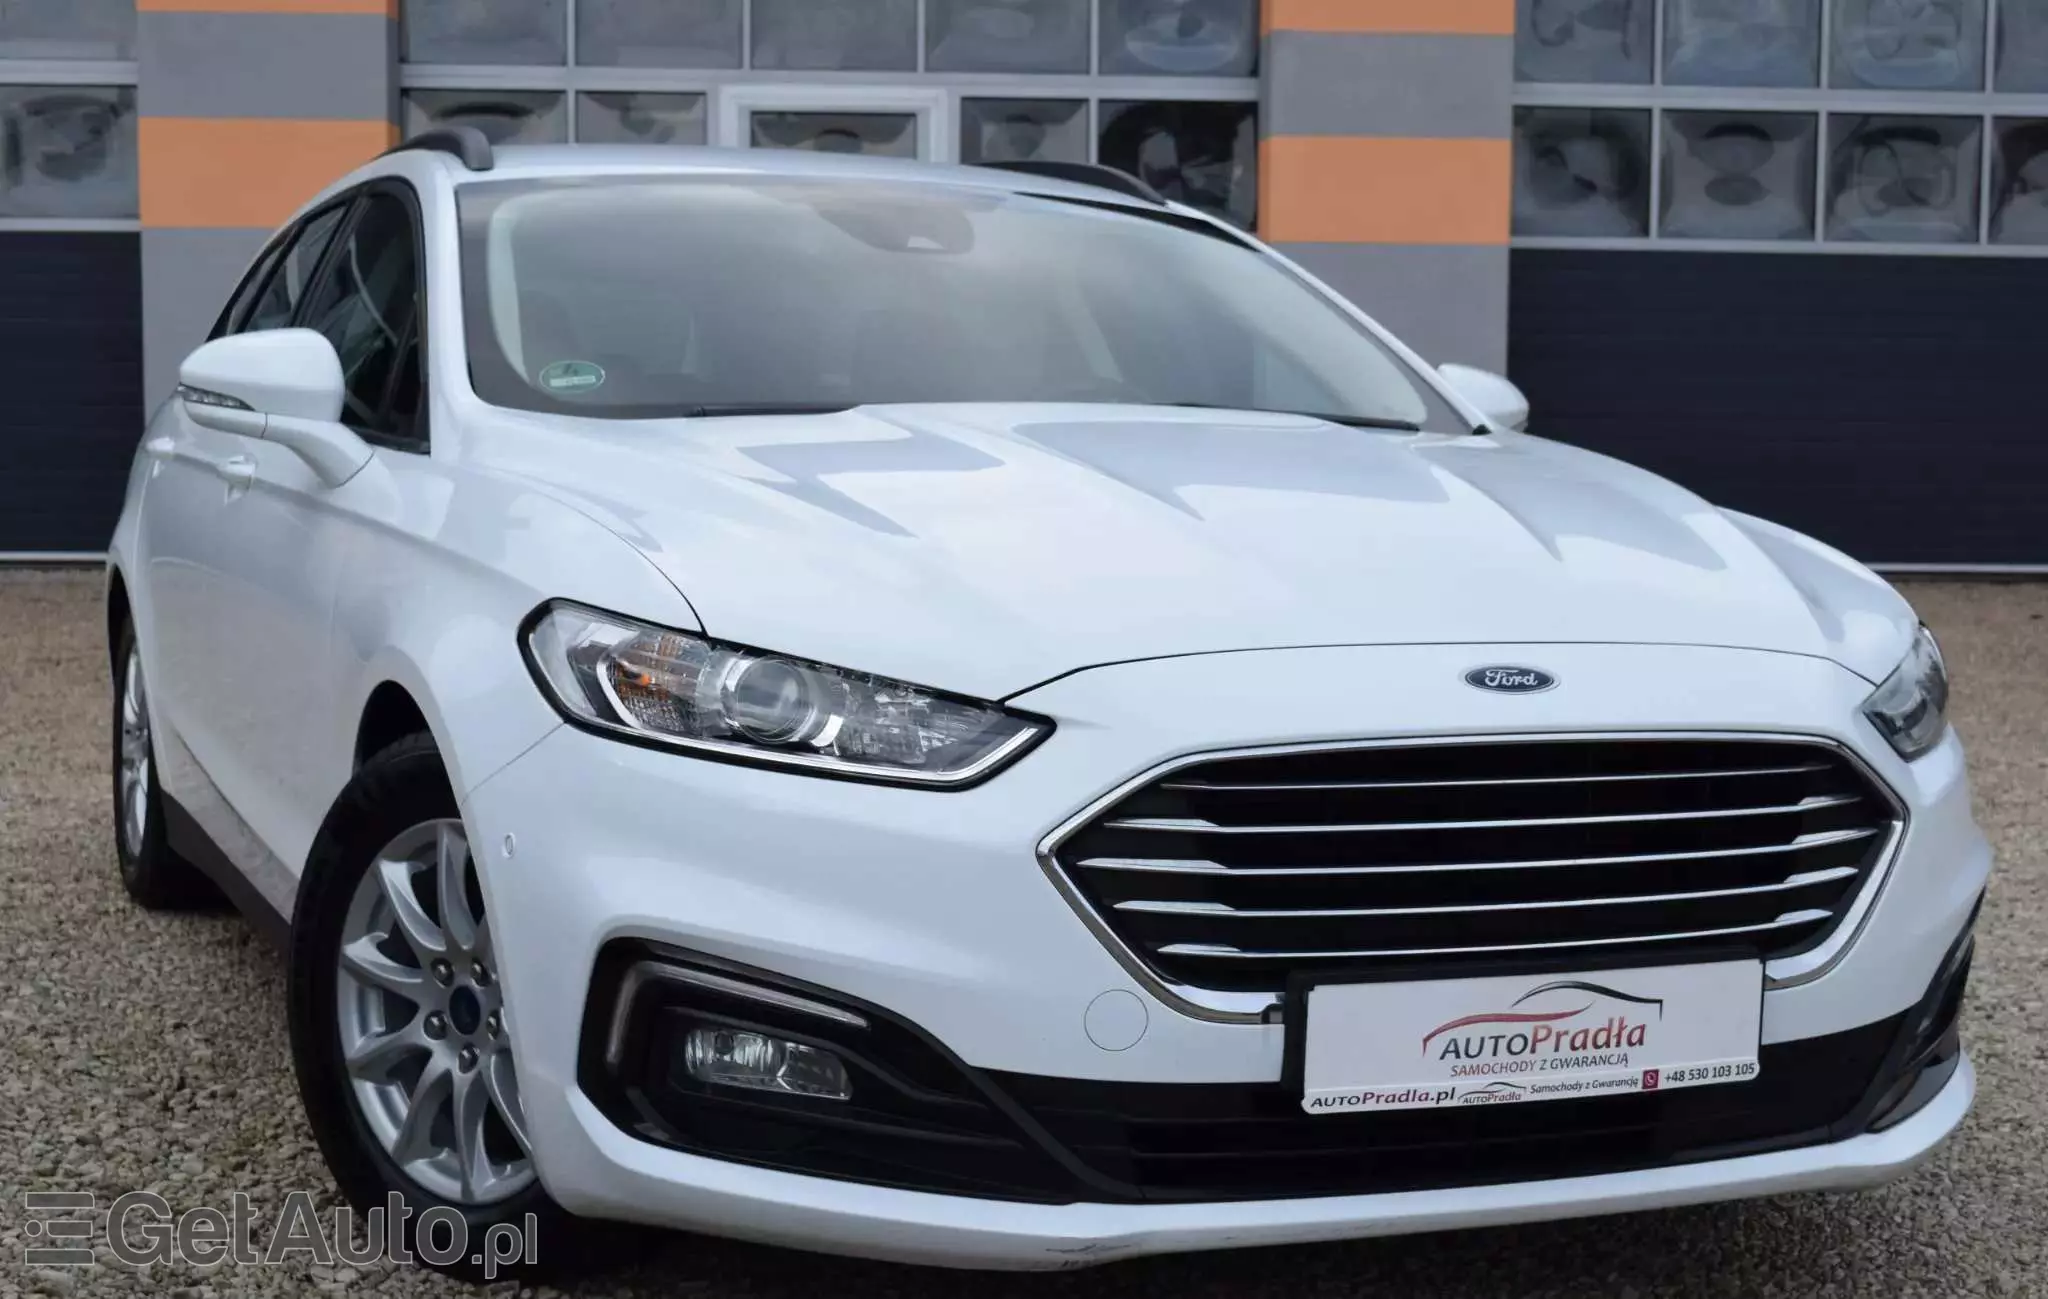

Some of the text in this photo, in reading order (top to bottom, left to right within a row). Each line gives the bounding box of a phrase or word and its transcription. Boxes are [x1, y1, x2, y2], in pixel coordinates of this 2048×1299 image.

[1485, 669, 1538, 686] Ford
[1451, 1052, 1629, 1077] SAMOCHODY Z GWARANCJĄ
[1664, 1062, 1755, 1082] +48 530 103 105
[1530, 1079, 1583, 1095] Samochody
